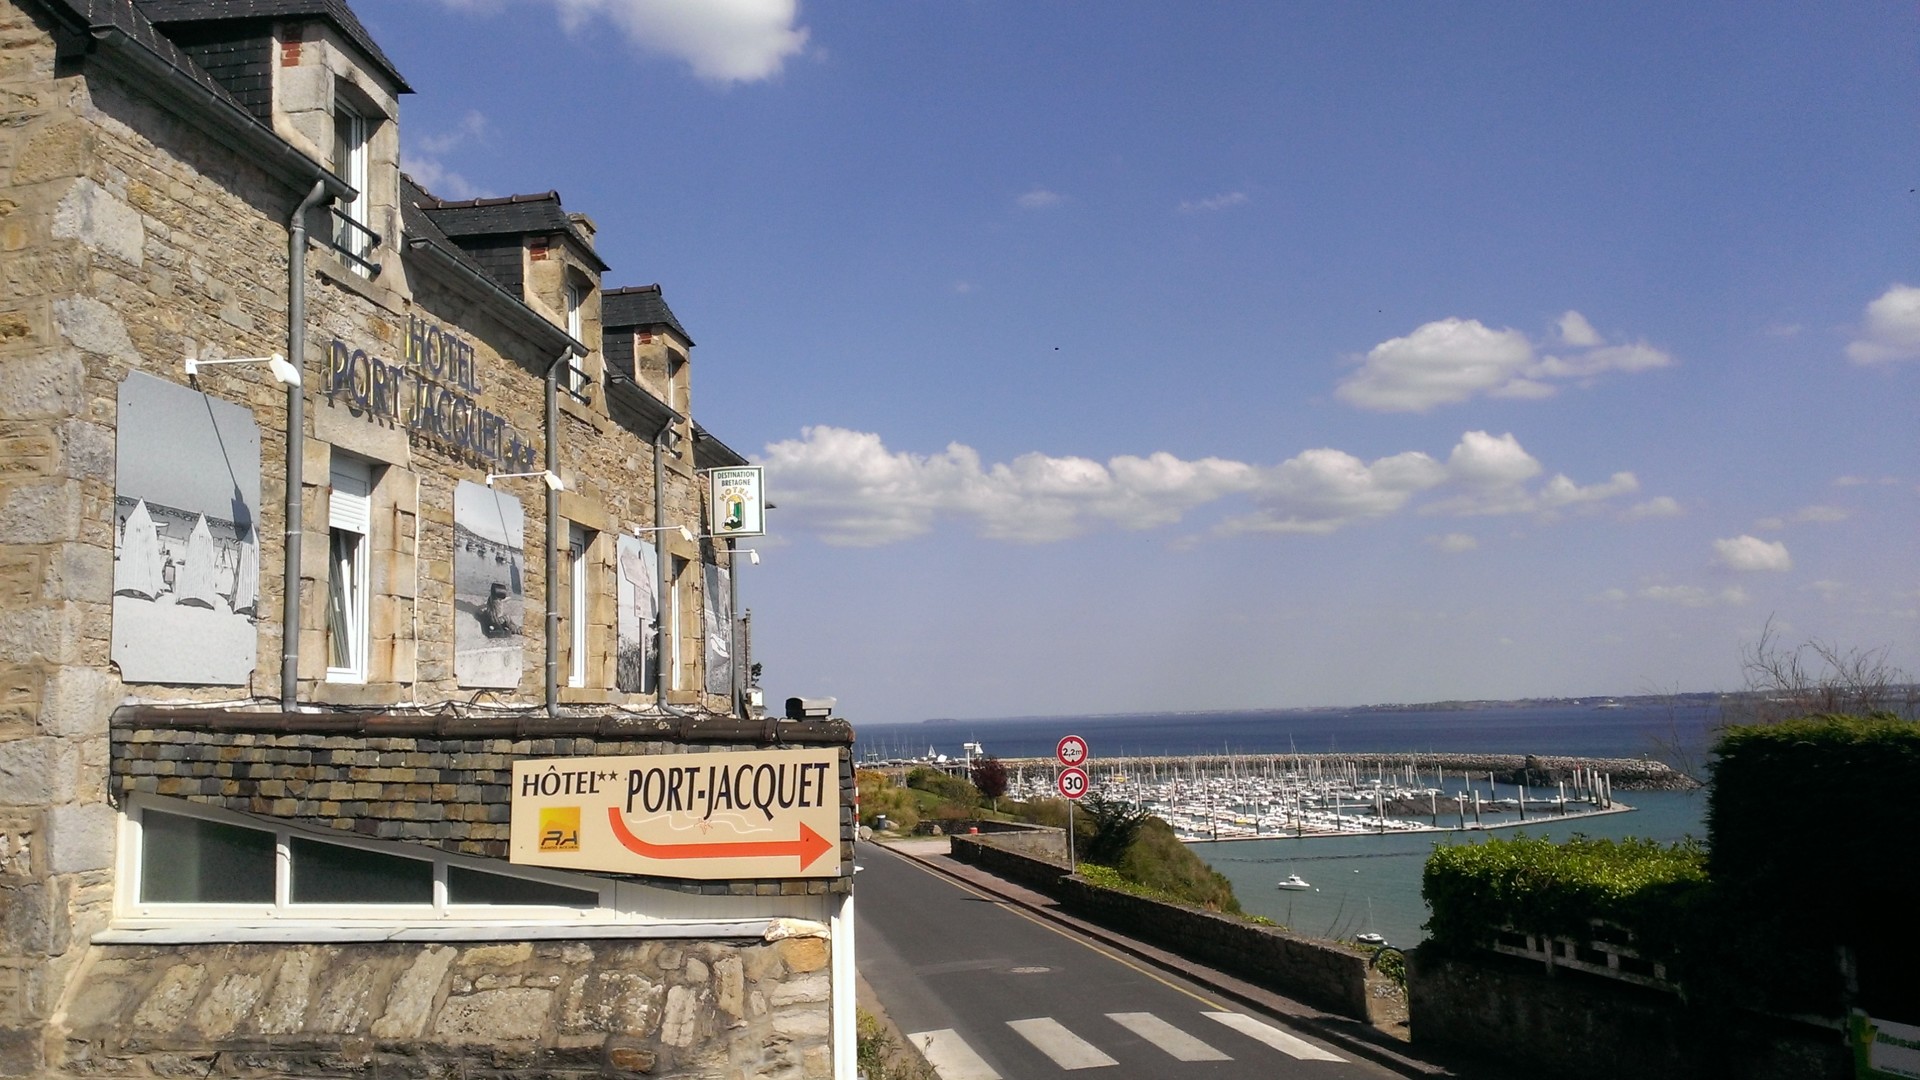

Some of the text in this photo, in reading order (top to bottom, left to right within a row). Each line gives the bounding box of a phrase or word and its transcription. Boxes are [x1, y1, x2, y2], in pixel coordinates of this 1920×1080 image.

[406, 313, 481, 396] HOTEL
[329, 338, 506, 461] PORT JACQUET
[717, 471, 755, 479] DESTINATION
[721, 479, 751, 487] BRETAGNE
[522, 762, 830, 822] HÔTEL PORT-JACQUET
[1065, 777, 1082, 790] 30
